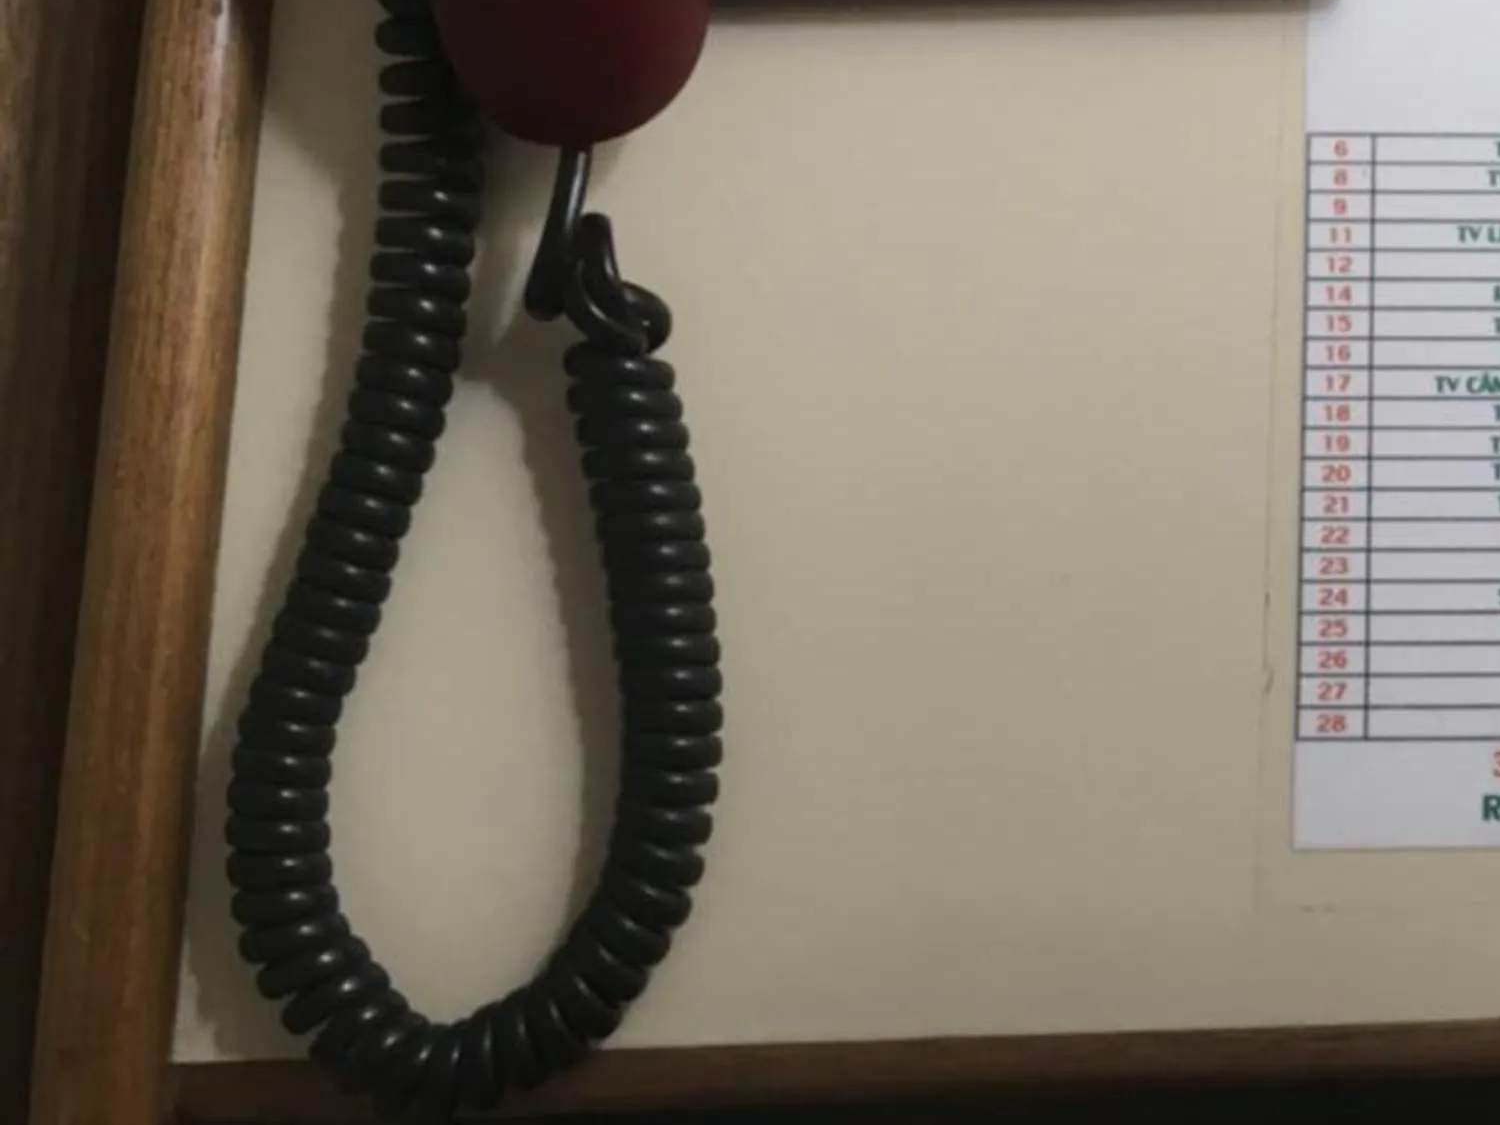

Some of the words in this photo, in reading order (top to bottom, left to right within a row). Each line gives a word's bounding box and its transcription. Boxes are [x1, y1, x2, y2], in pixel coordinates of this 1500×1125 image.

[1334, 142, 1348, 157] 6
[1334, 171, 1348, 186] 8
[1333, 199, 1348, 214] 9
[1328, 228, 1352, 243] 11
[1457, 227, 1484, 243] TV
[1327, 257, 1353, 273] 12
[1326, 286, 1352, 302] 14
[1325, 316, 1351, 331] 15
[1325, 345, 1350, 361] 16
[1325, 376, 1351, 391] 17
[1434, 377, 1462, 393] TV
[1323, 406, 1350, 421] 18
[1323, 435, 1350, 451] 19
[1321, 466, 1350, 482] 20
[1323, 497, 1349, 512] 21
[1321, 527, 1349, 543] 22
[1319, 558, 1349, 574] 23
[1319, 589, 1348, 605] 24
[1318, 620, 1348, 636] 25
[1318, 652, 1347, 668] 26
[1317, 684, 1347, 700] 27
[1316, 715, 1346, 732] 28
